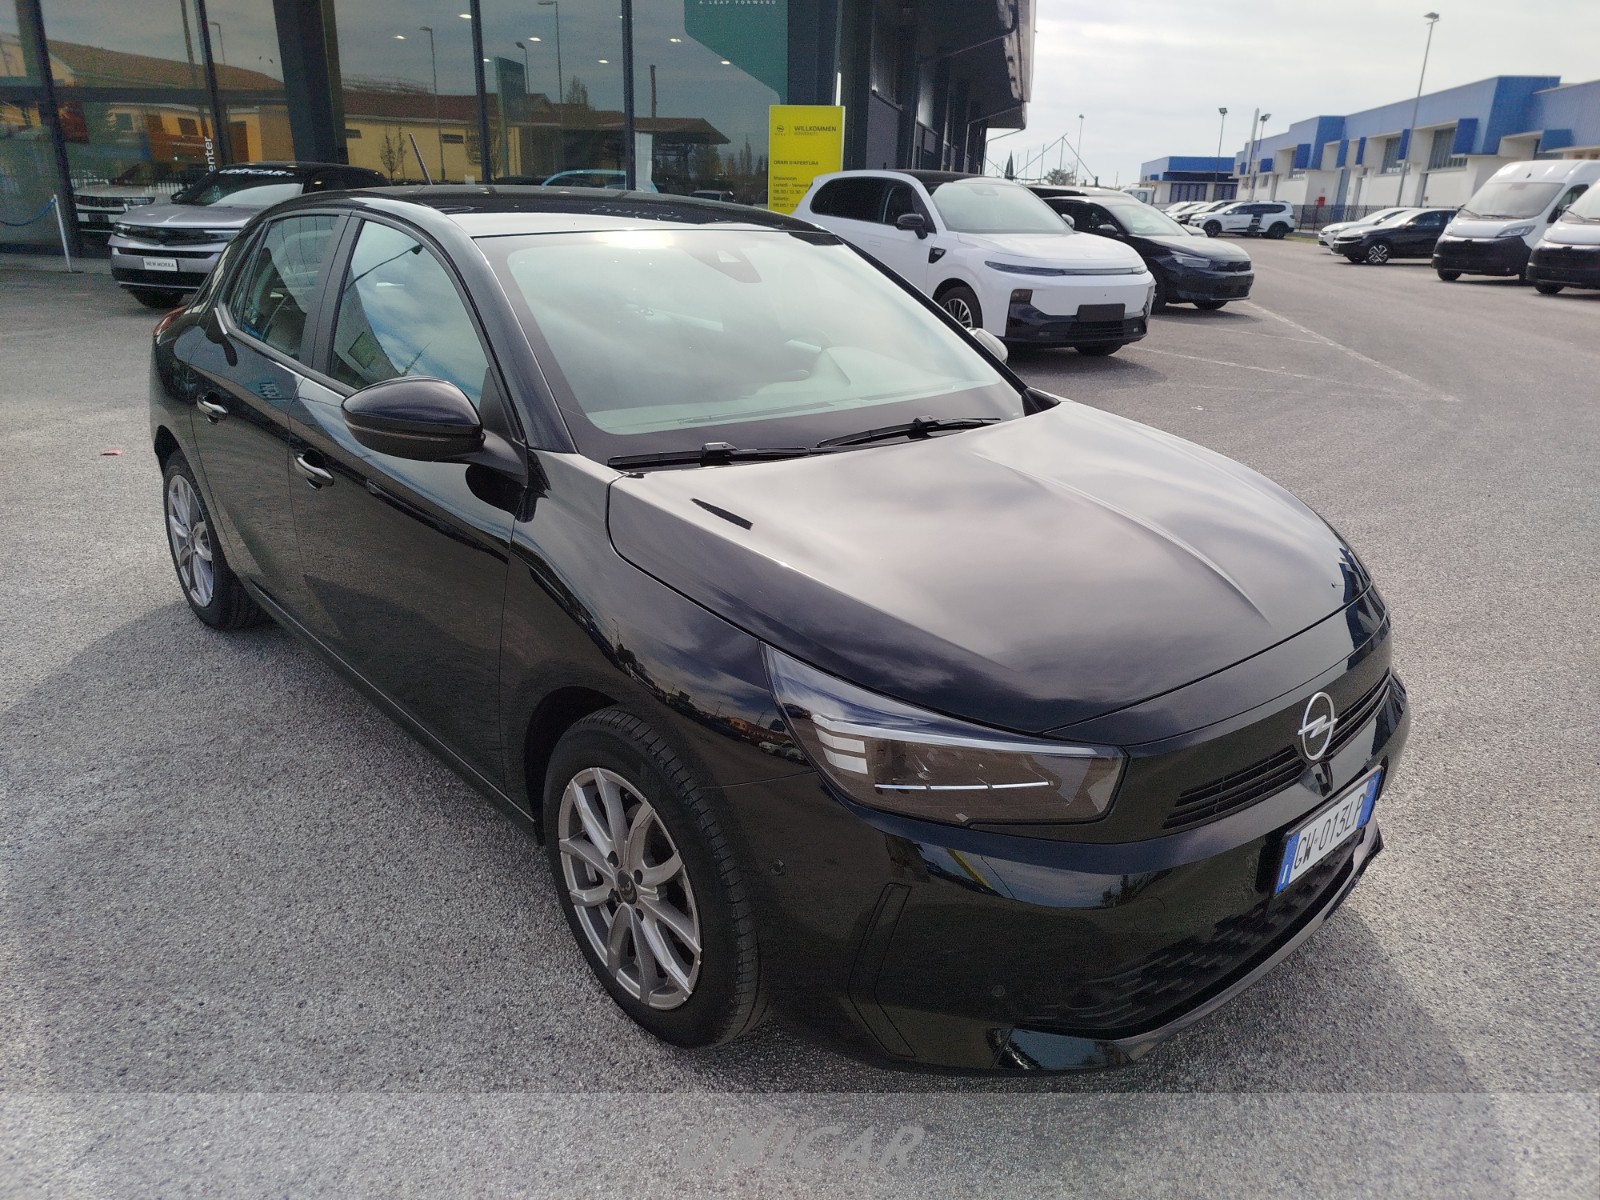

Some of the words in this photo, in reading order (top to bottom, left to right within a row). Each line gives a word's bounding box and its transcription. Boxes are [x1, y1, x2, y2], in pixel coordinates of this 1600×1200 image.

[205, 136, 215, 172] enter
[1293, 828, 1317, 870] GW
[1318, 793, 1365, 851] 013LP
